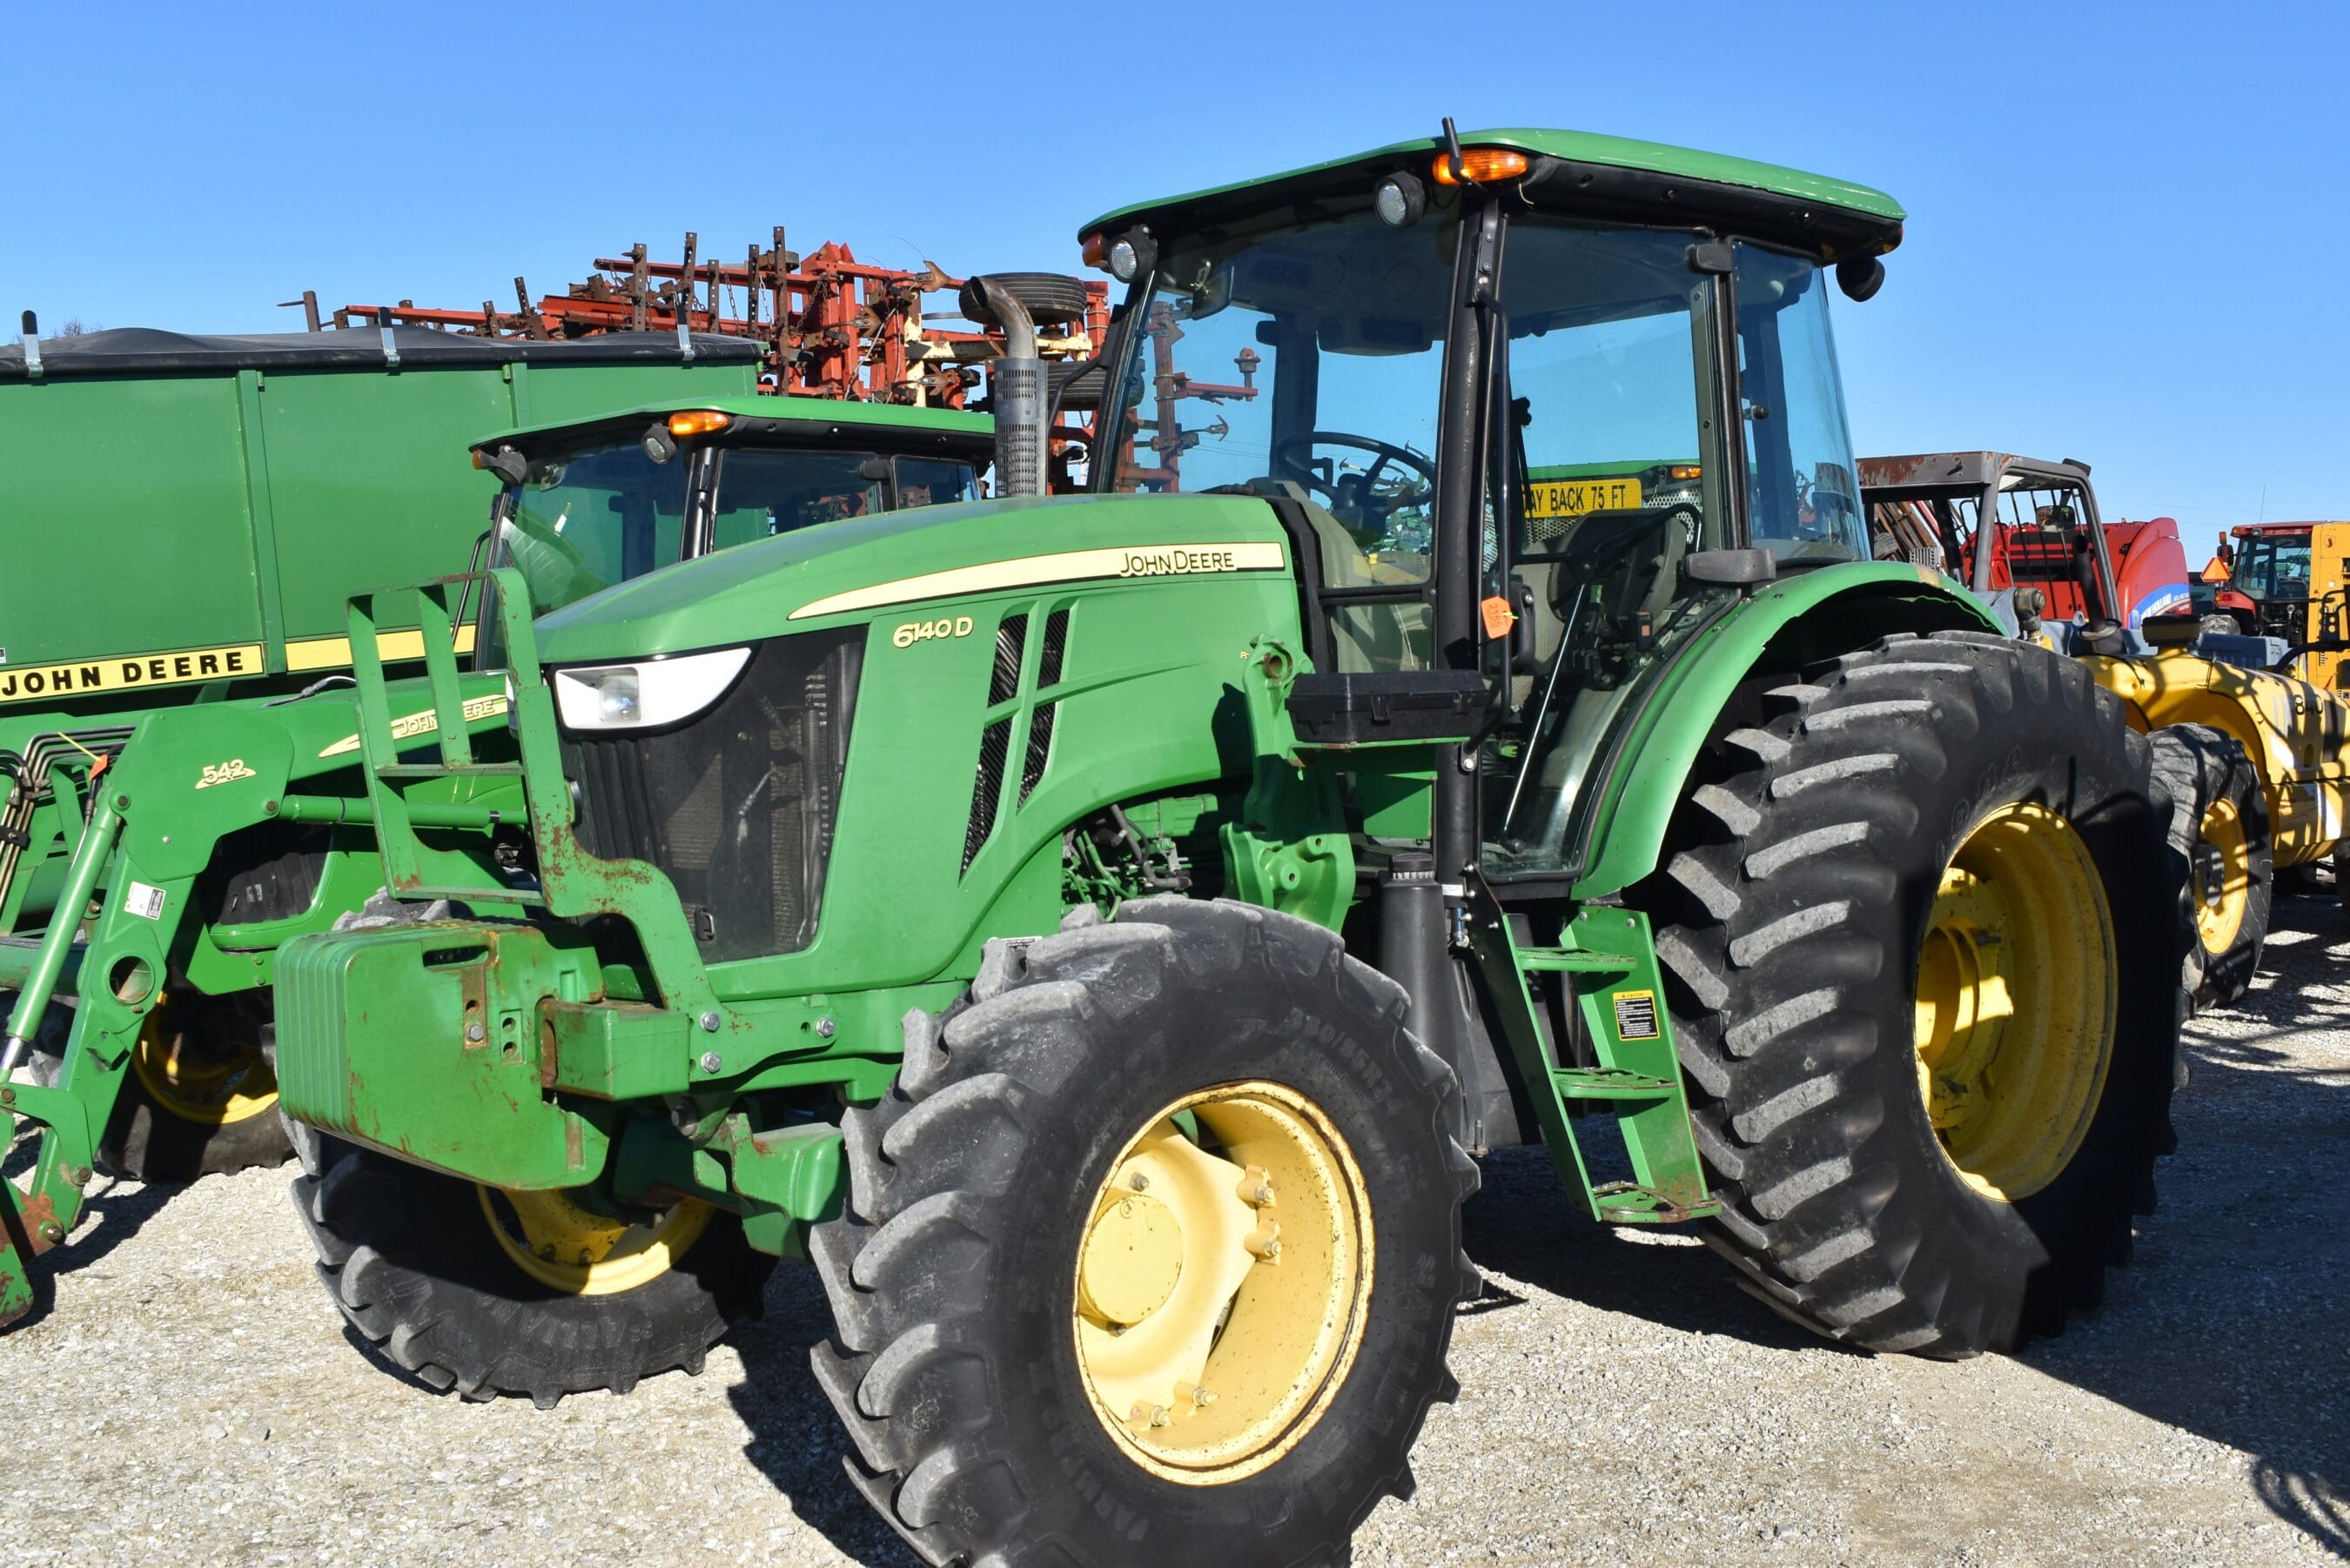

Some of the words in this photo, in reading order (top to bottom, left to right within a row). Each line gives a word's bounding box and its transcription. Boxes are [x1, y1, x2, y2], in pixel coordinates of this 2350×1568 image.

[1550, 487, 1584, 511] BACK
[1591, 486, 1605, 509] 75
[1612, 485, 1626, 508] FT
[1120, 553, 1172, 573] JOHN
[1173, 550, 1234, 570] DEERE
[2, 667, 102, 696] JOHN
[122, 652, 244, 684] DEERE
[463, 700, 494, 719] ERE
[203, 759, 247, 785] 542
